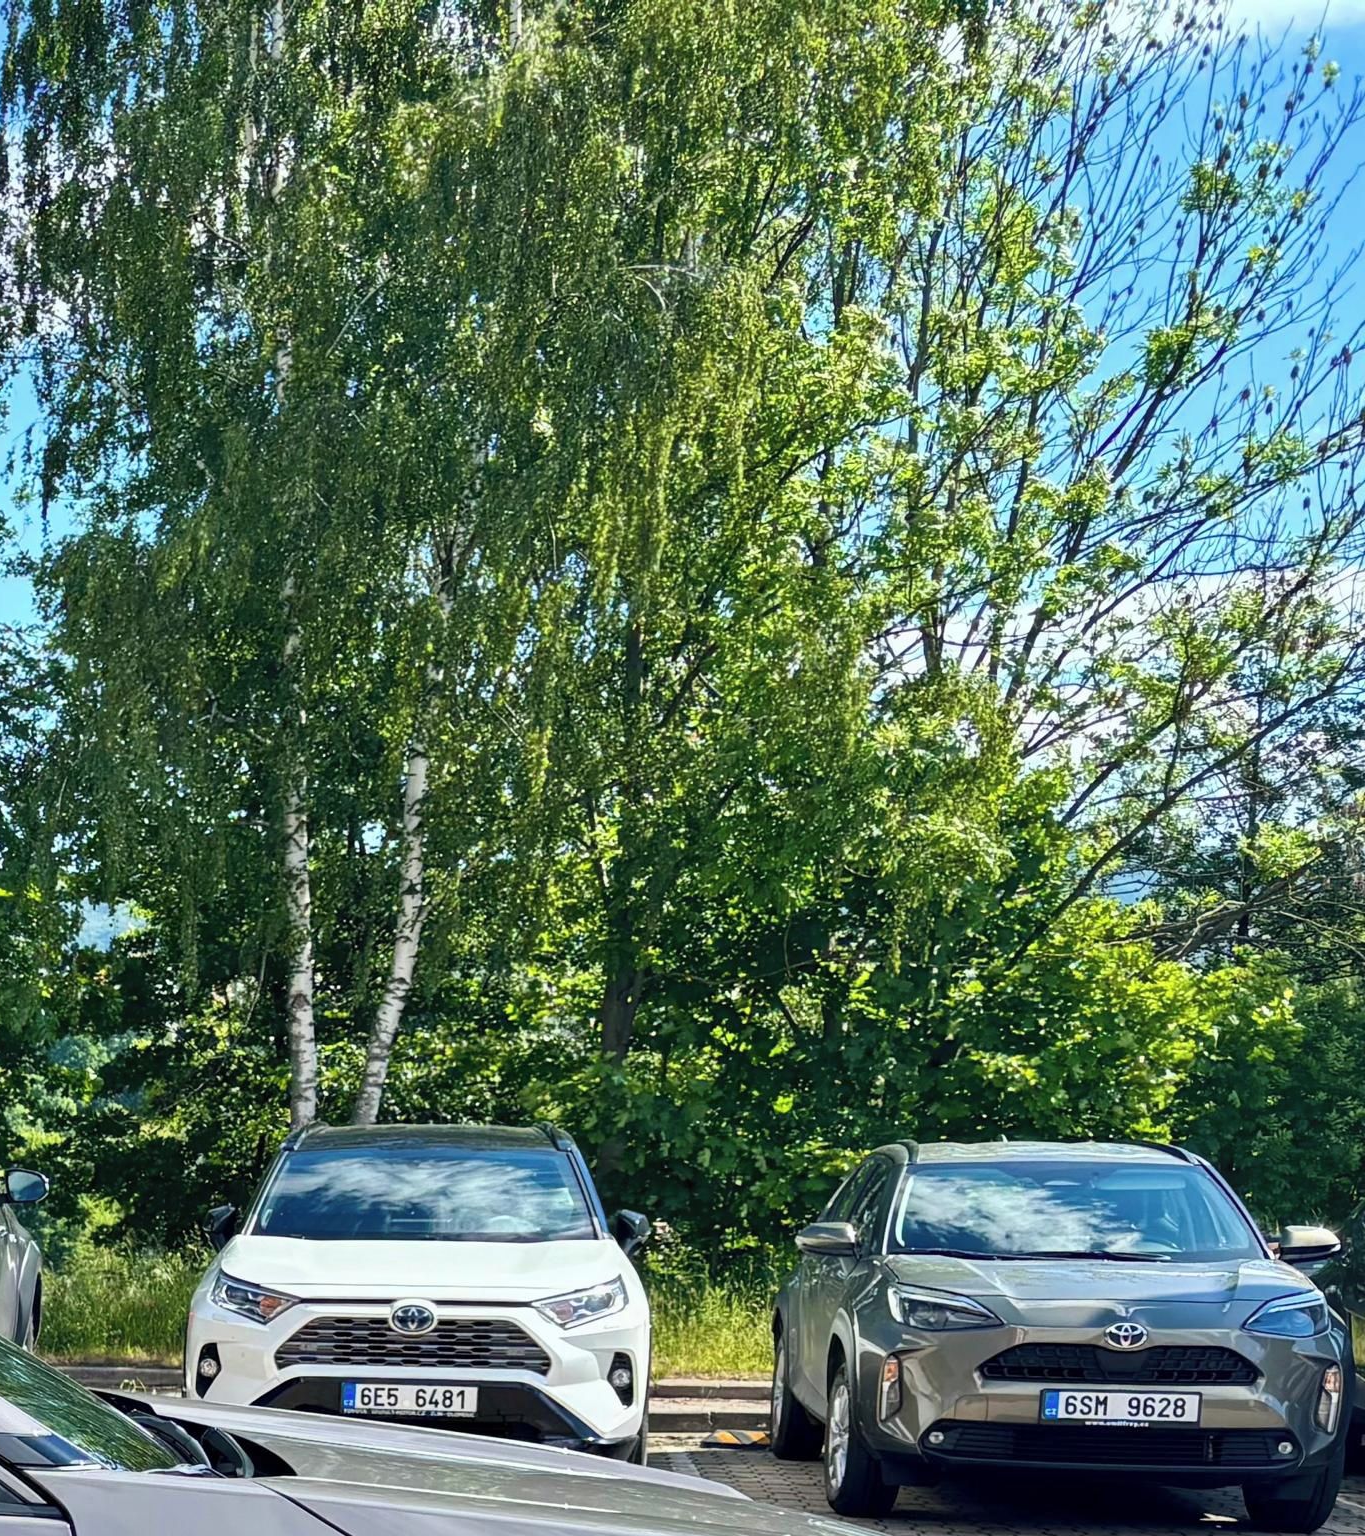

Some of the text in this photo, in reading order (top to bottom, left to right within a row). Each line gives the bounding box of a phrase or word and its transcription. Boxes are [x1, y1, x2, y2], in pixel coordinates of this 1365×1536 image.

[360, 1387, 399, 1407] 6E5
[415, 1388, 467, 1410] 6481
[1064, 1395, 1109, 1417] 6SM
[1127, 1396, 1187, 1419] 9628
